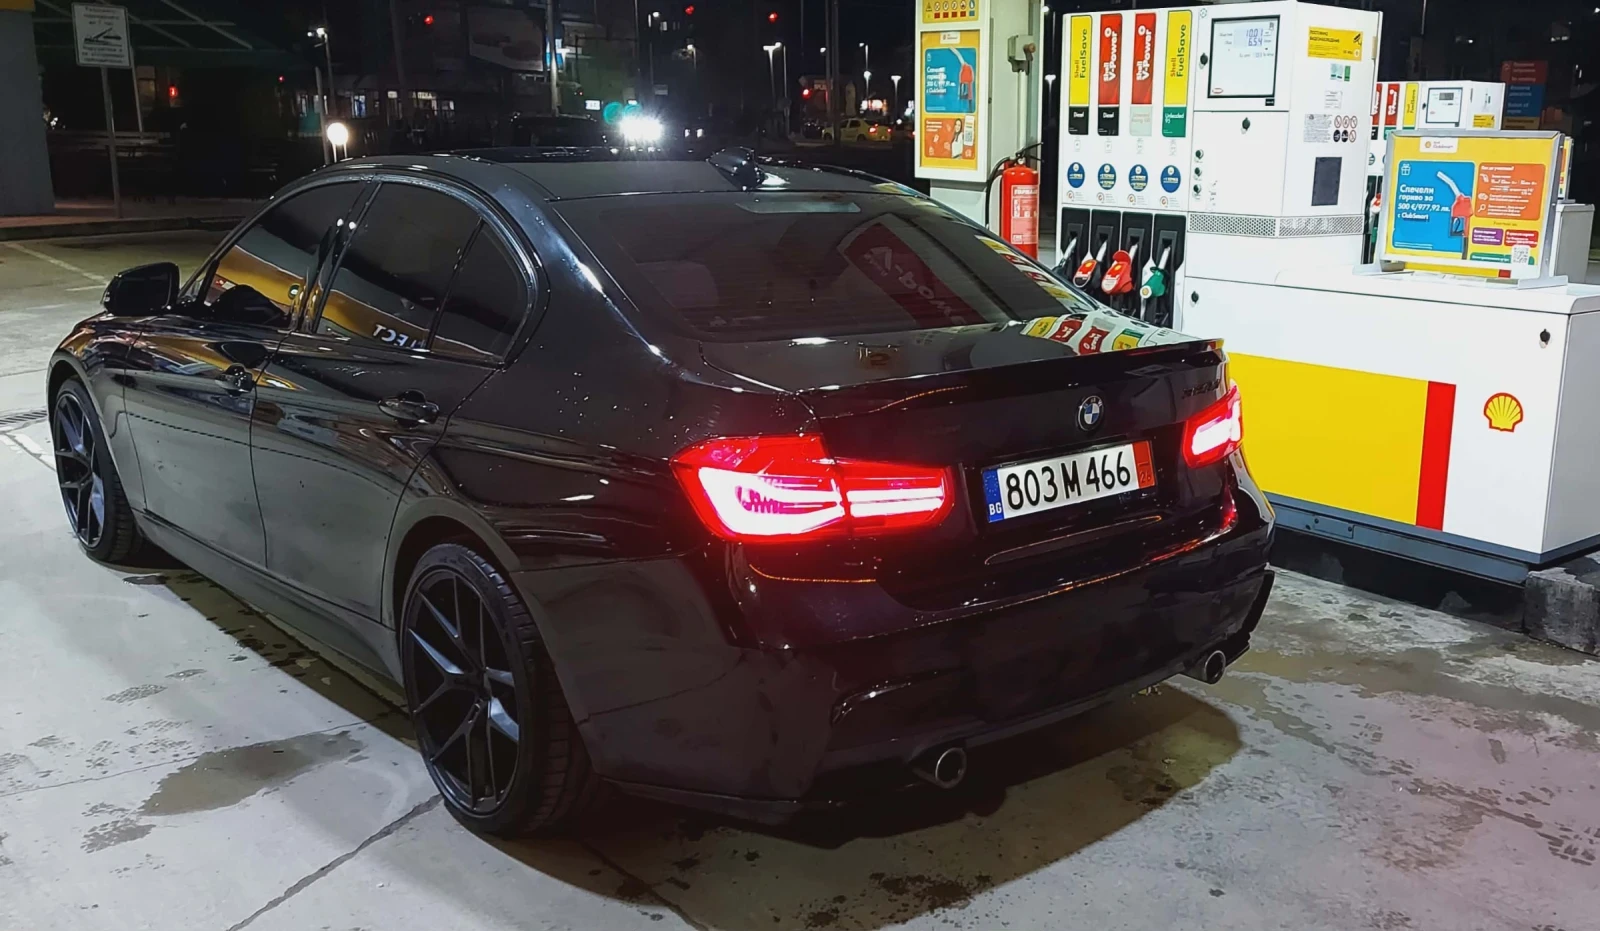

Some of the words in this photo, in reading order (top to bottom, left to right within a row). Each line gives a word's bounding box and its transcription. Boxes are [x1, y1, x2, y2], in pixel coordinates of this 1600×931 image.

[1079, 28, 1088, 79] FuelSave
[1108, 30, 1118, 82] V-Power
[1140, 29, 1152, 81] V-Power
[1176, 24, 1187, 78] FuelSave
[1398, 194, 1423, 203] гориво
[1399, 183, 1435, 194] Спечели
[1401, 211, 1429, 220] ClubSmart
[1005, 465, 1059, 510] 803
[1060, 458, 1082, 499] M
[1085, 450, 1131, 493] 466
[988, 501, 1003, 515] BG
